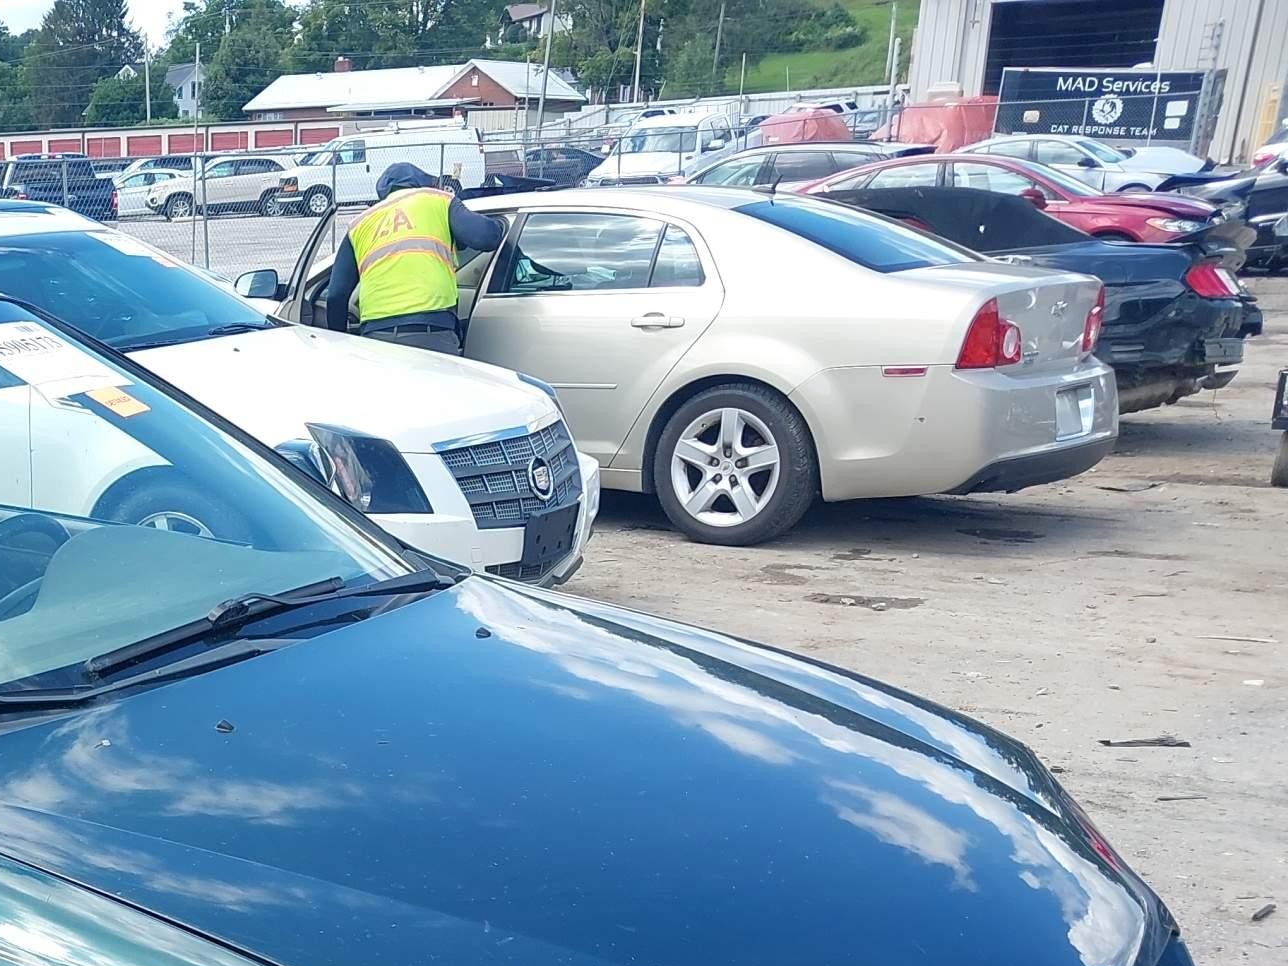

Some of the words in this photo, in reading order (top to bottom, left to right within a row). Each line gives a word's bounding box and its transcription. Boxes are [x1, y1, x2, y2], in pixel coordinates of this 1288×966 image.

[1056, 76, 1099, 92] MAD
[1101, 77, 1171, 93] Services
[1050, 124, 1070, 134] CAT
[1071, 125, 1127, 135] RESPONSE
[1130, 127, 1158, 136] TEAM
